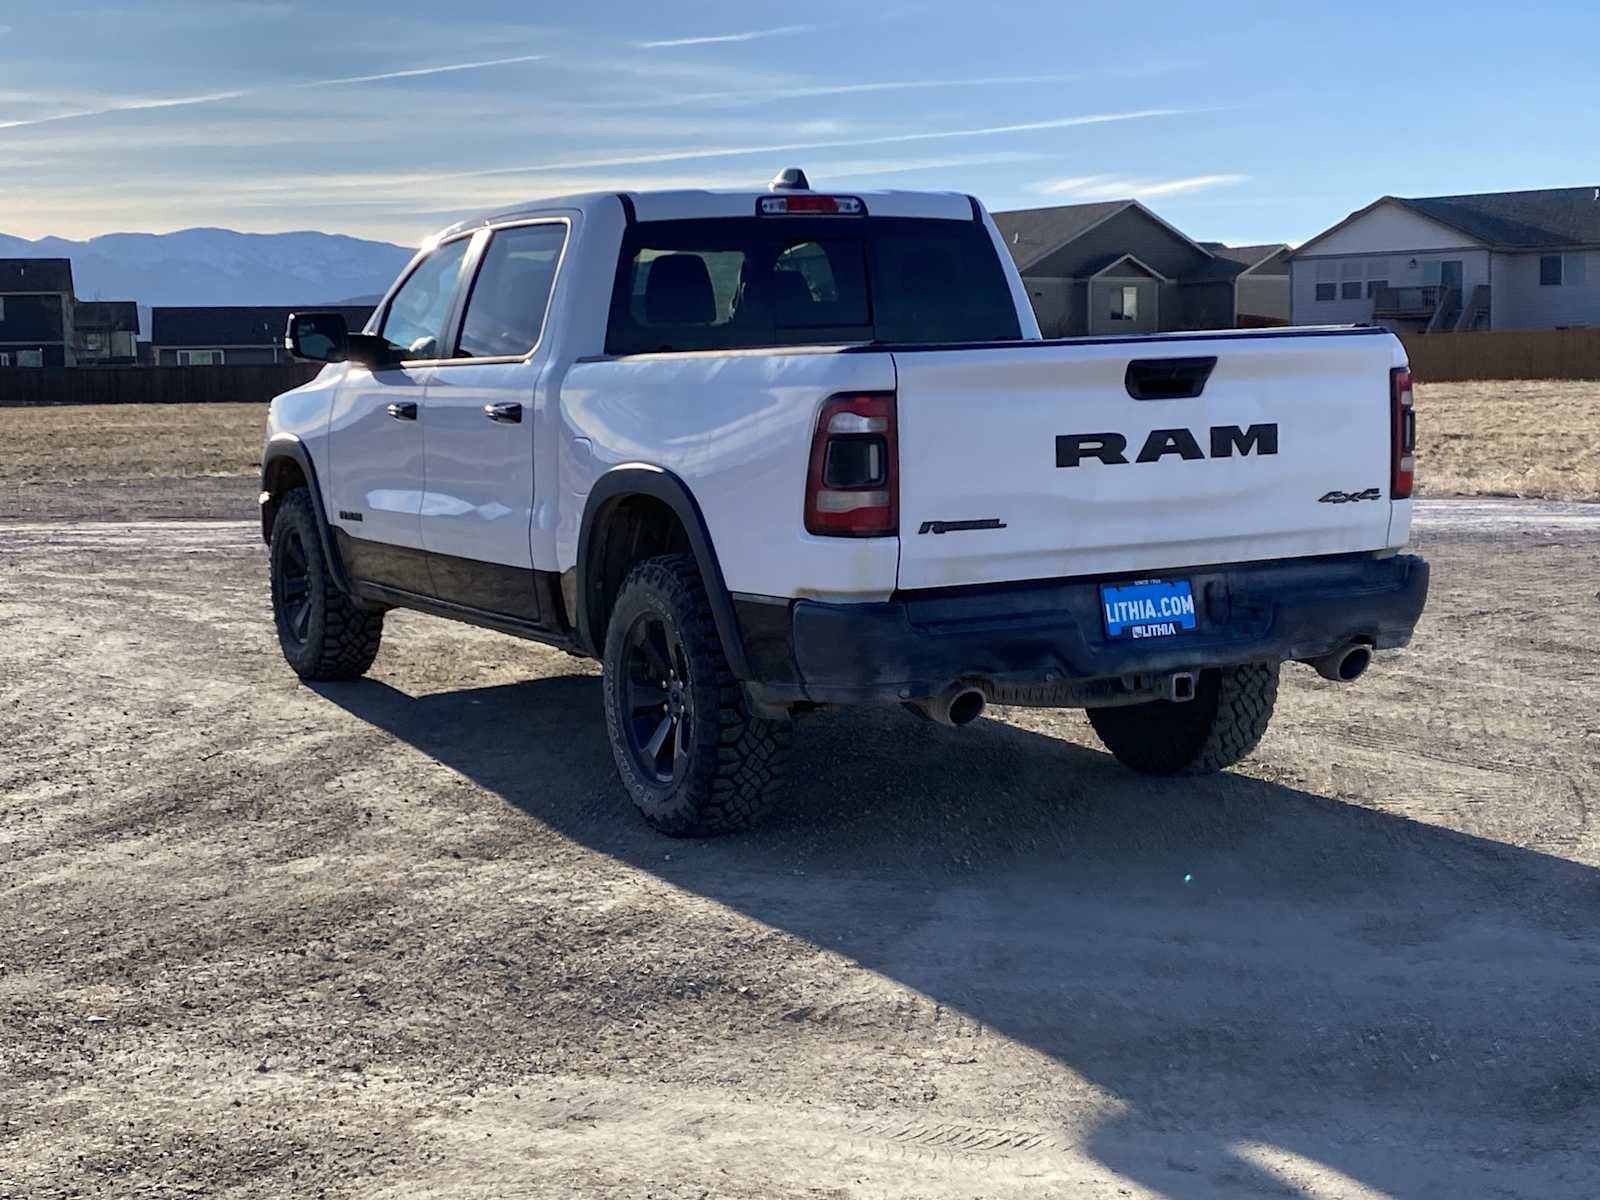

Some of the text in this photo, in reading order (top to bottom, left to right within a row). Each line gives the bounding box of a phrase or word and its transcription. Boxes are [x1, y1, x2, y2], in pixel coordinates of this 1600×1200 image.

[1055, 423, 1278, 468] RAM
[1105, 594, 1195, 624] LITHIA.COM
[1142, 623, 1176, 637] LITHIA
